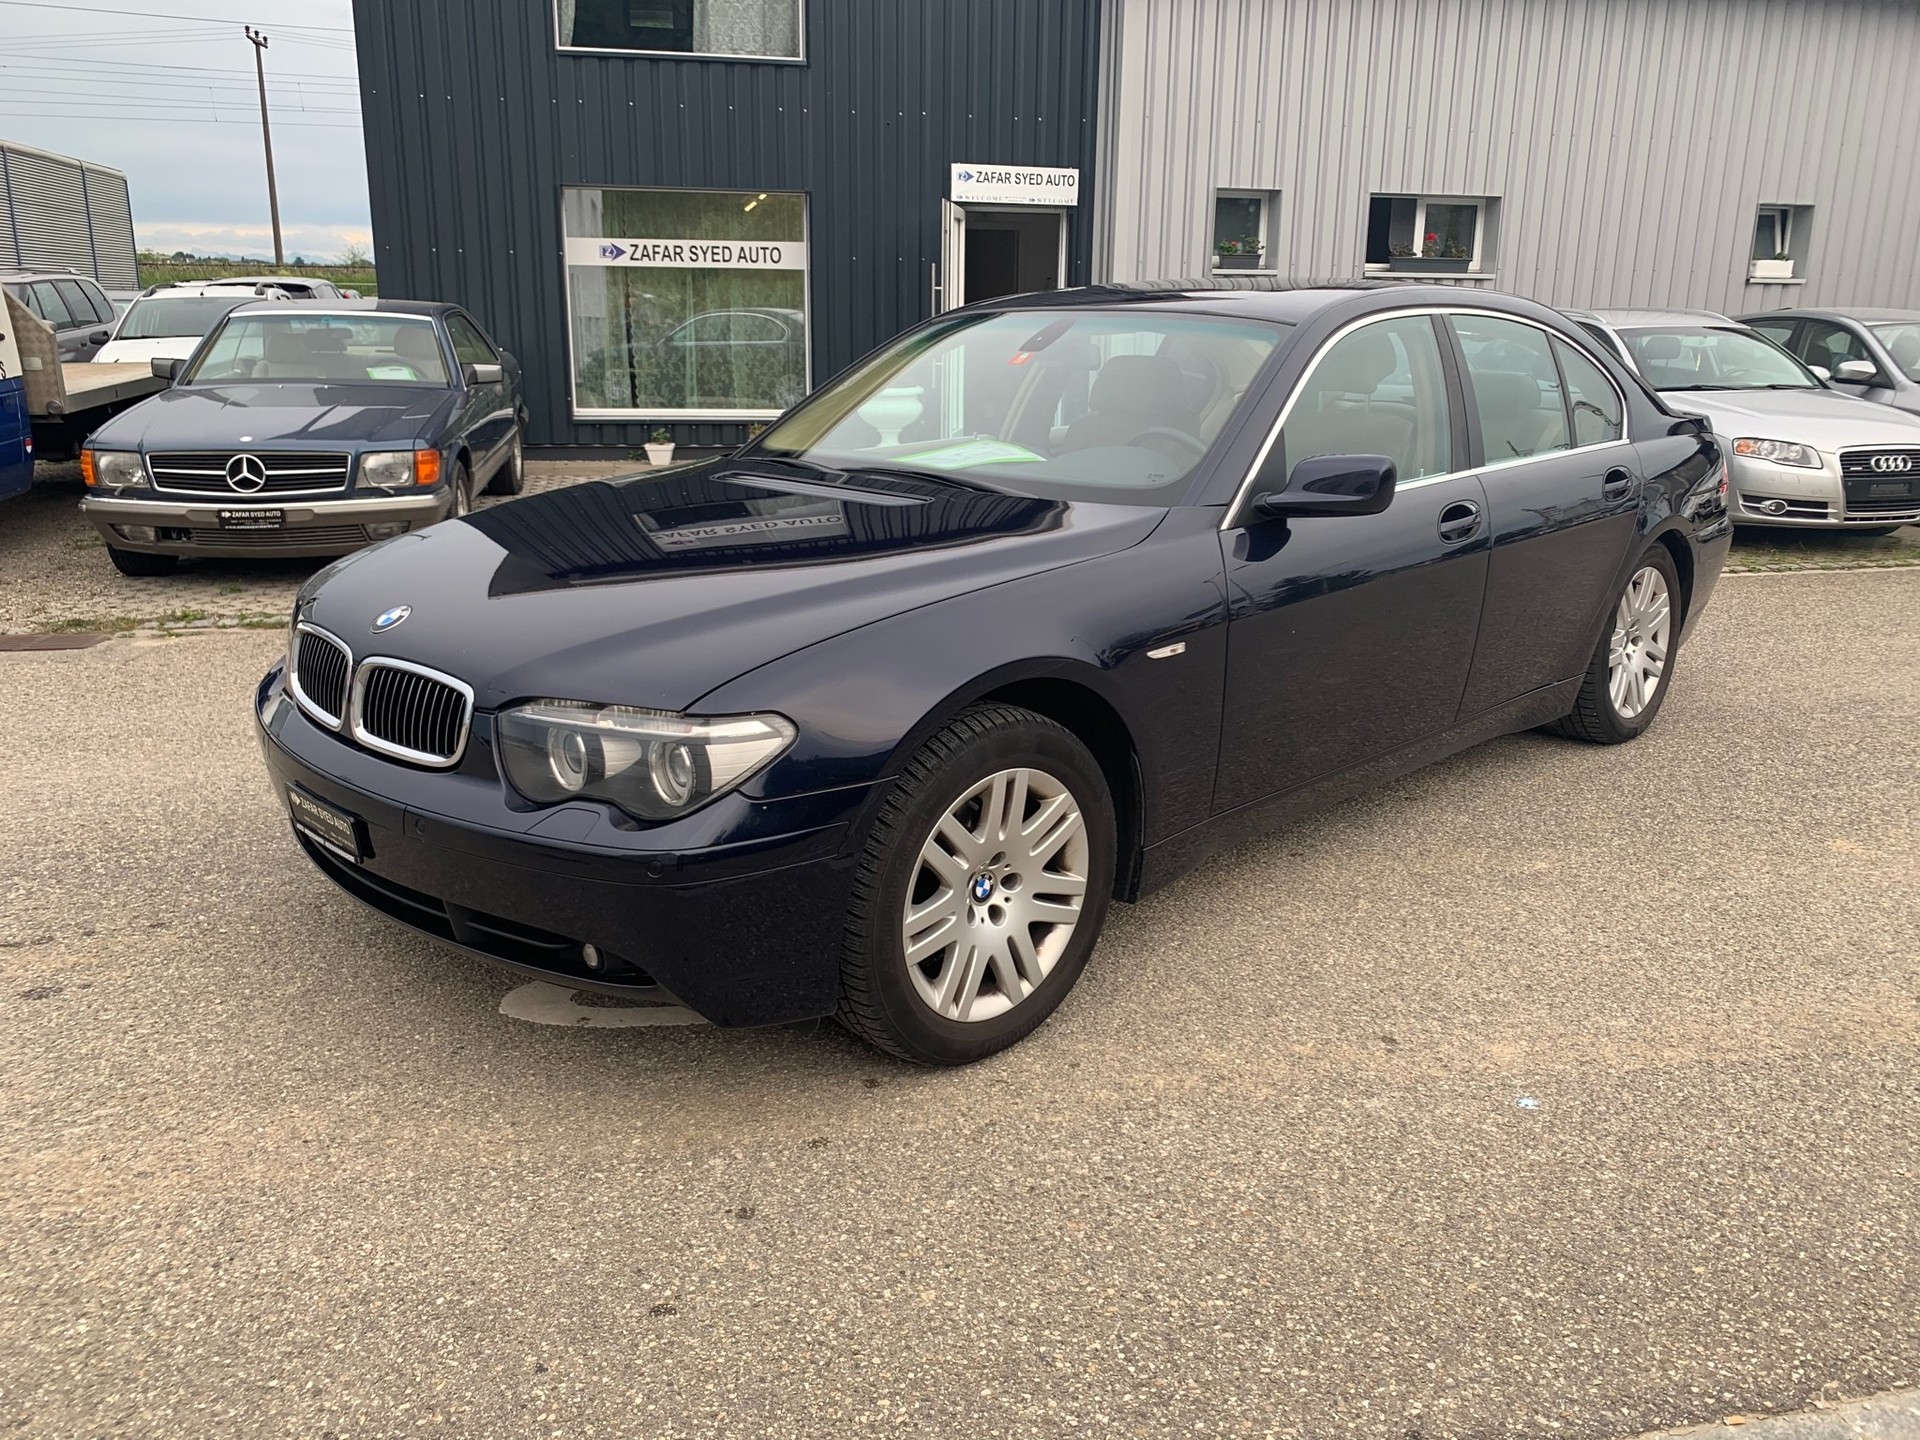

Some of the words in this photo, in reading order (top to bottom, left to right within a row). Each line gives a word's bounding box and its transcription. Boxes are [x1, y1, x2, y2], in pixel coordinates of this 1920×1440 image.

[976, 171, 1011, 184] ZAFAR
[1015, 173, 1043, 185] SYED
[1045, 174, 1075, 187] AUTO
[629, 243, 685, 262] ZAFAR
[689, 245, 733, 263] SYED
[737, 246, 782, 264] AUTO
